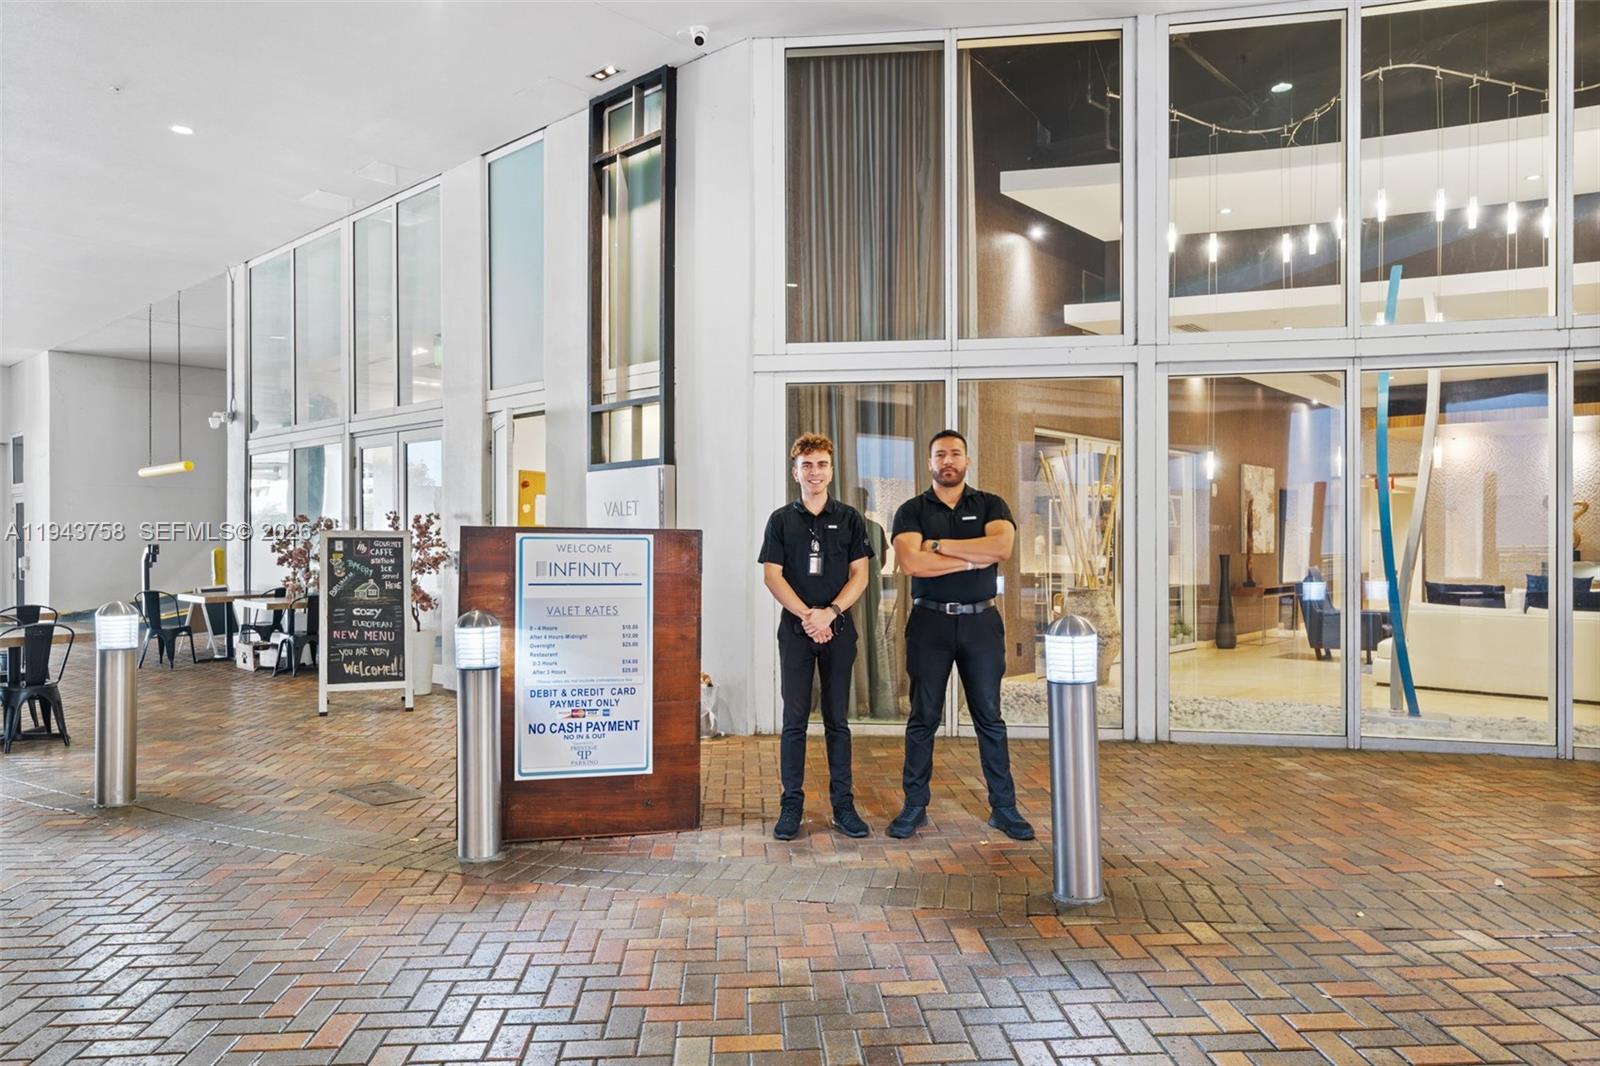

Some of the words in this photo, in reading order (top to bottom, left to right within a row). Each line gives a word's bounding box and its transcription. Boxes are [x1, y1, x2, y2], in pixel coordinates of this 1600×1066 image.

[603, 500, 639, 517] VALET
[370, 548, 393, 556] CAFFE
[556, 544, 612, 553] WELCOME
[549, 562, 621, 577] INFINITY
[546, 606, 579, 616] VALET
[585, 605, 618, 616] RATES
[352, 620, 393, 628] EUROPEAN
[333, 630, 358, 639] NEW
[364, 631, 395, 641] MENU
[356, 647, 368, 656] ARE
[371, 647, 390, 657] VERY
[530, 689, 558, 698] DEBIT
[561, 689, 567, 697] &
[571, 688, 605, 697] CREDIT
[610, 687, 636, 696] CARD
[549, 699, 593, 708] PAYMENT
[596, 698, 620, 707] ONLY
[528, 723, 546, 734] NO
[549, 722, 582, 734] CASH
[585, 720, 640, 733] PAYMENT
